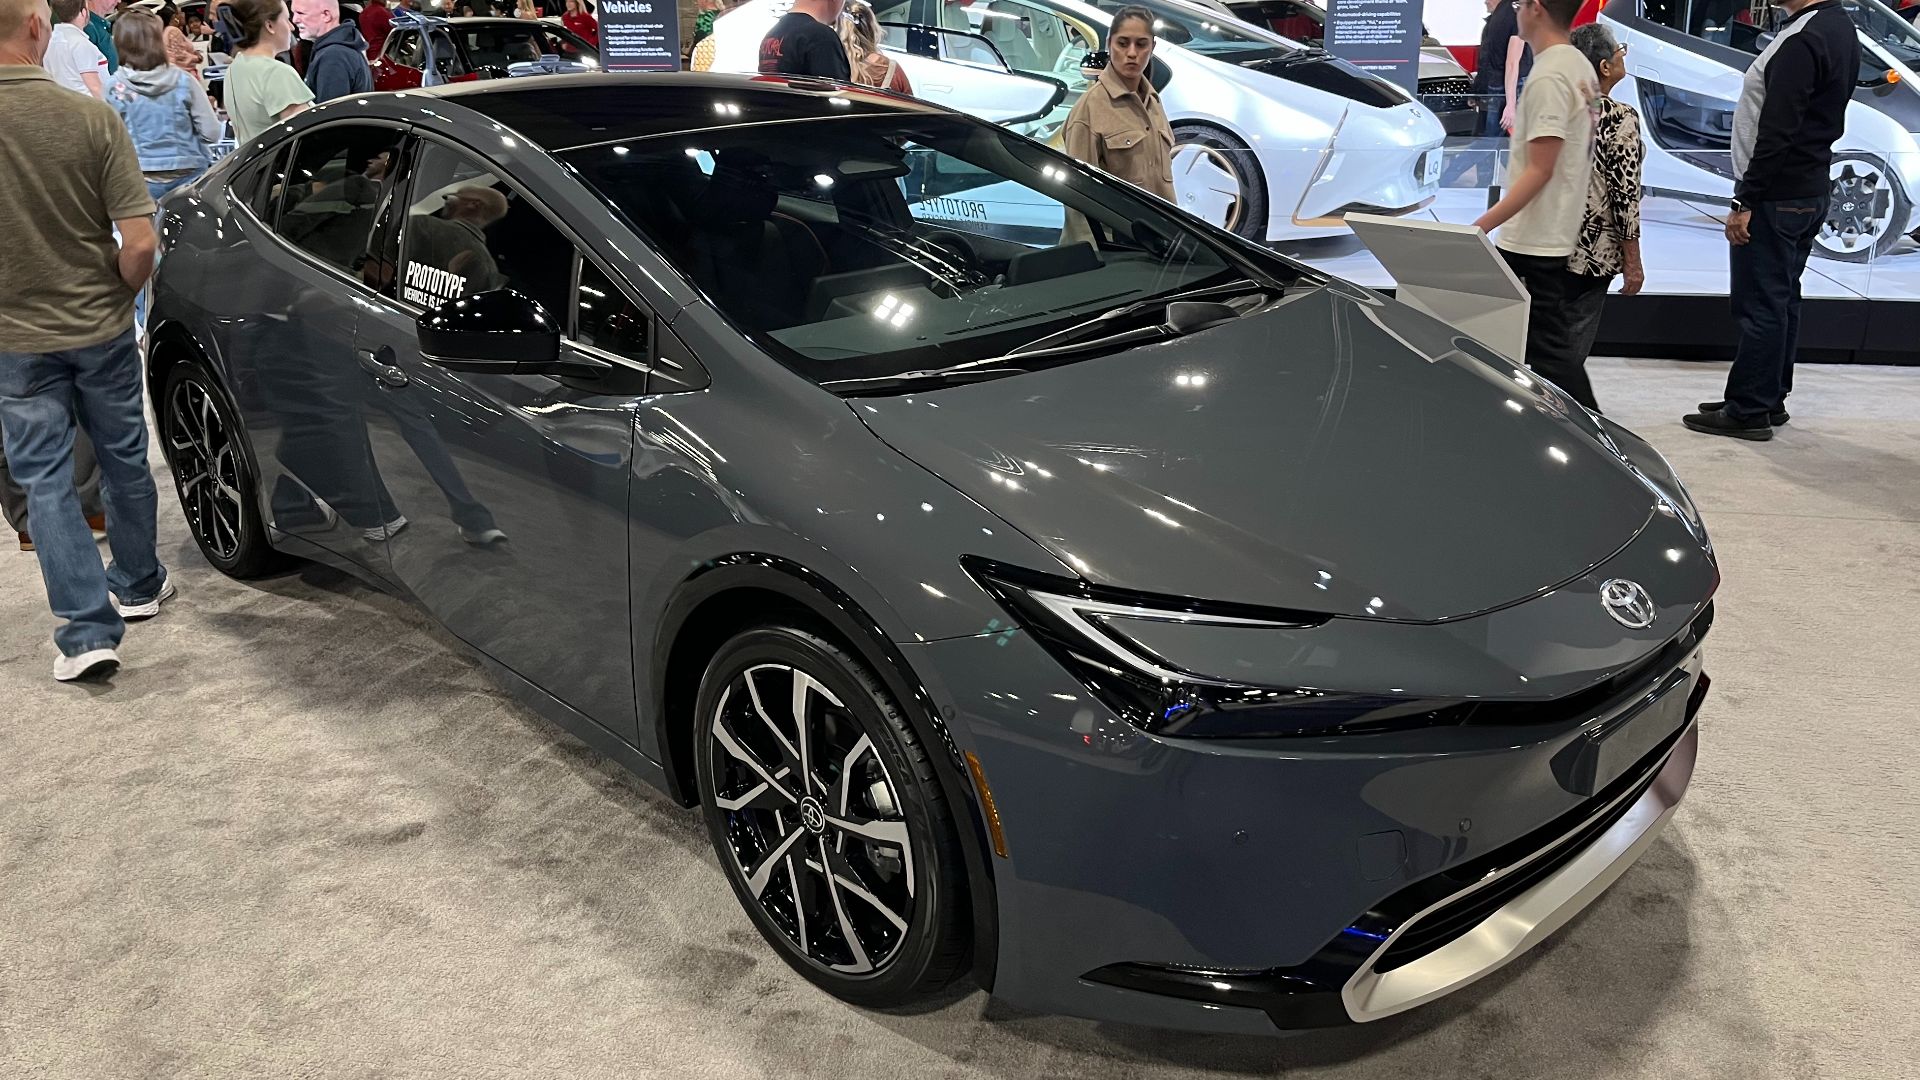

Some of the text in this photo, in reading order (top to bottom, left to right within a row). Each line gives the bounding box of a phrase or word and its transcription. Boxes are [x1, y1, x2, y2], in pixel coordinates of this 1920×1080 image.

[602, 1, 652, 13] Vehicles
[1428, 161, 1438, 175] LQ
[405, 261, 466, 298] PROTOTYPE
[404, 286, 428, 305] VEHICLE
[428, 295, 436, 309] IS
